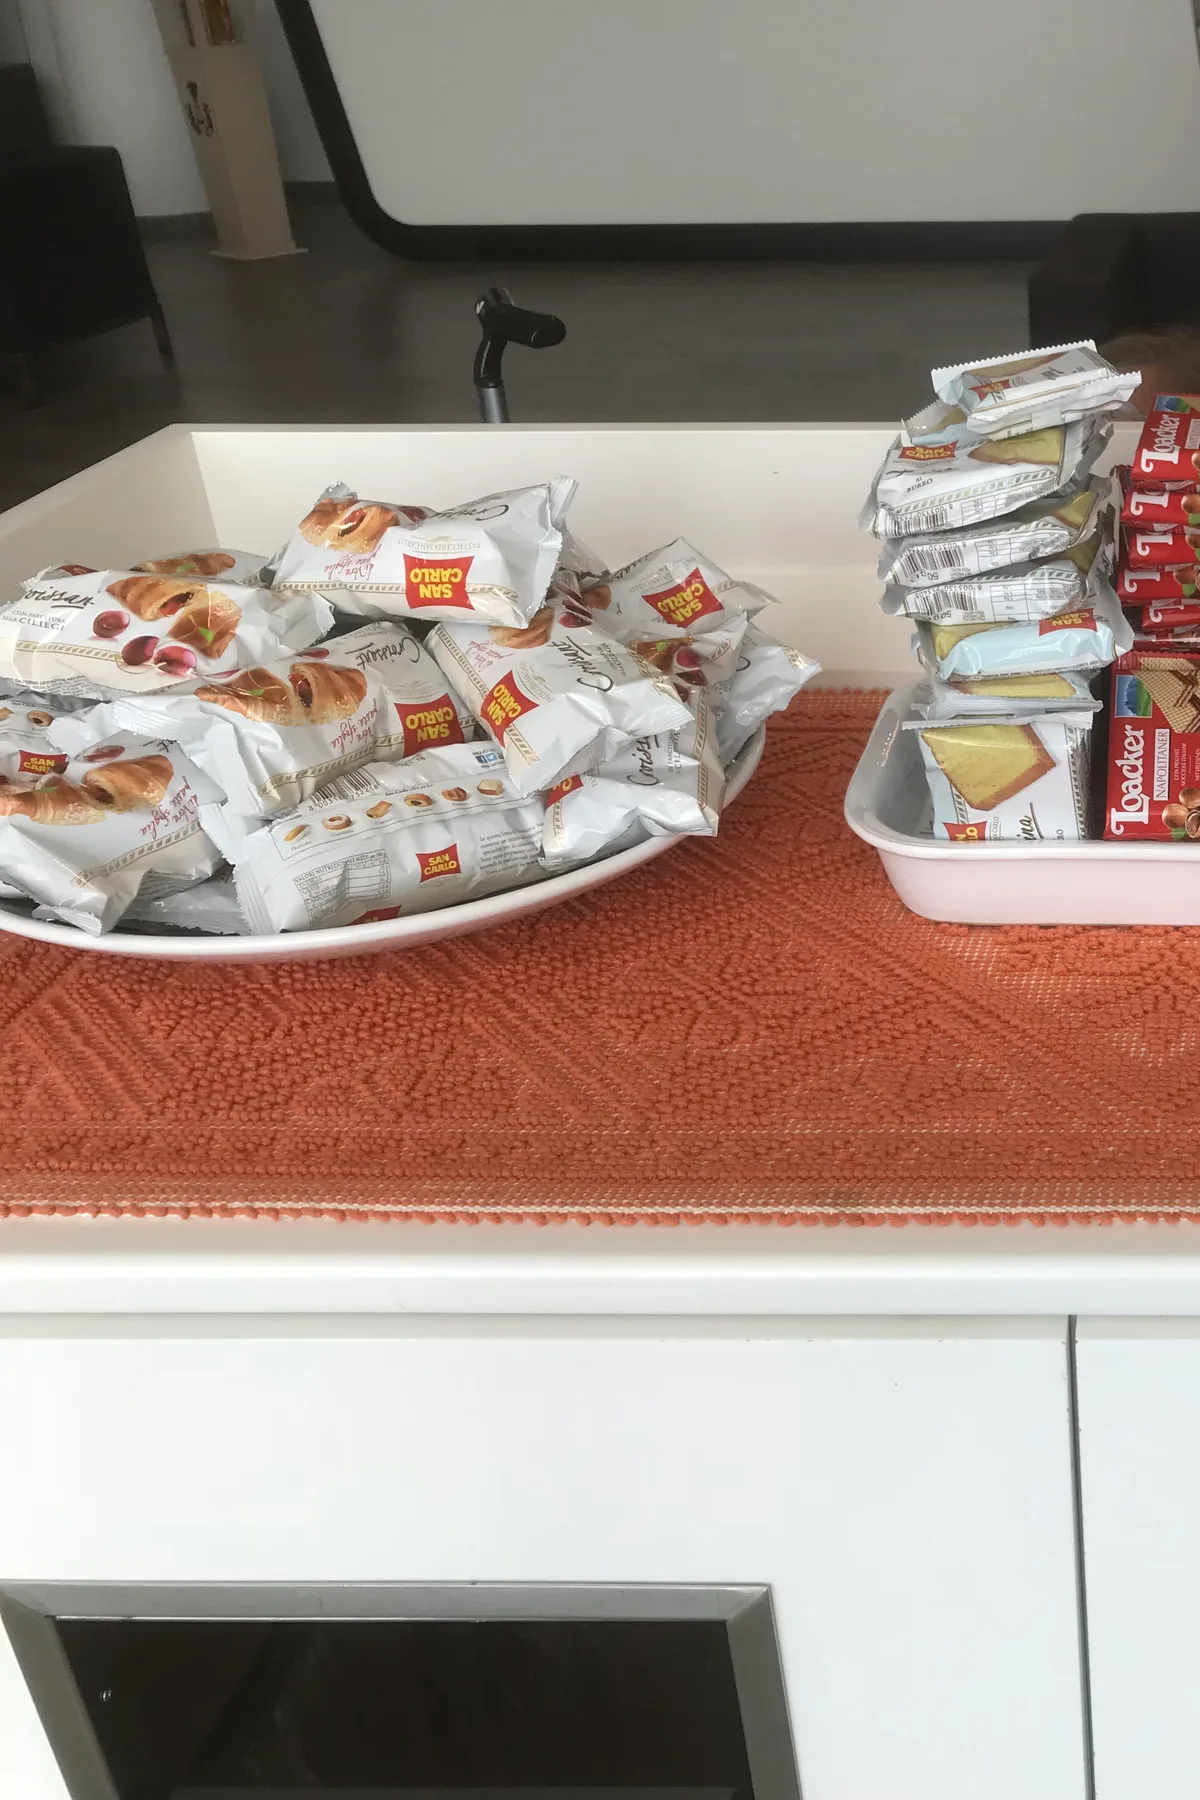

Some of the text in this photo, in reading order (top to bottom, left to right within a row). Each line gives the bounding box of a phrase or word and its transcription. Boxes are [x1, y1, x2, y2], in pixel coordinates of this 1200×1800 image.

[1141, 415, 1180, 472] Loacker
[906, 477, 933, 493] BURRO
[410, 568, 462, 583] CARLO
[419, 584, 452, 599] SAN
[658, 583, 704, 612] CARLO
[671, 599, 703, 622] SAN
[356, 637, 421, 670] Croissant
[493, 684, 522, 718] CARLO
[406, 707, 454, 729] CARLO
[487, 703, 506, 726] SAN
[417, 724, 450, 742] SAN
[23, 762, 52, 774] CAR
[29, 757, 55, 767] SAN
[626, 735, 660, 786] Croiss
[1156, 731, 1167, 798] NAPOLITANER
[1111, 724, 1150, 835] Loacker
[424, 861, 457, 875] CARLO
[428, 854, 449, 866] SAN
[295, 872, 316, 884] VALORI
